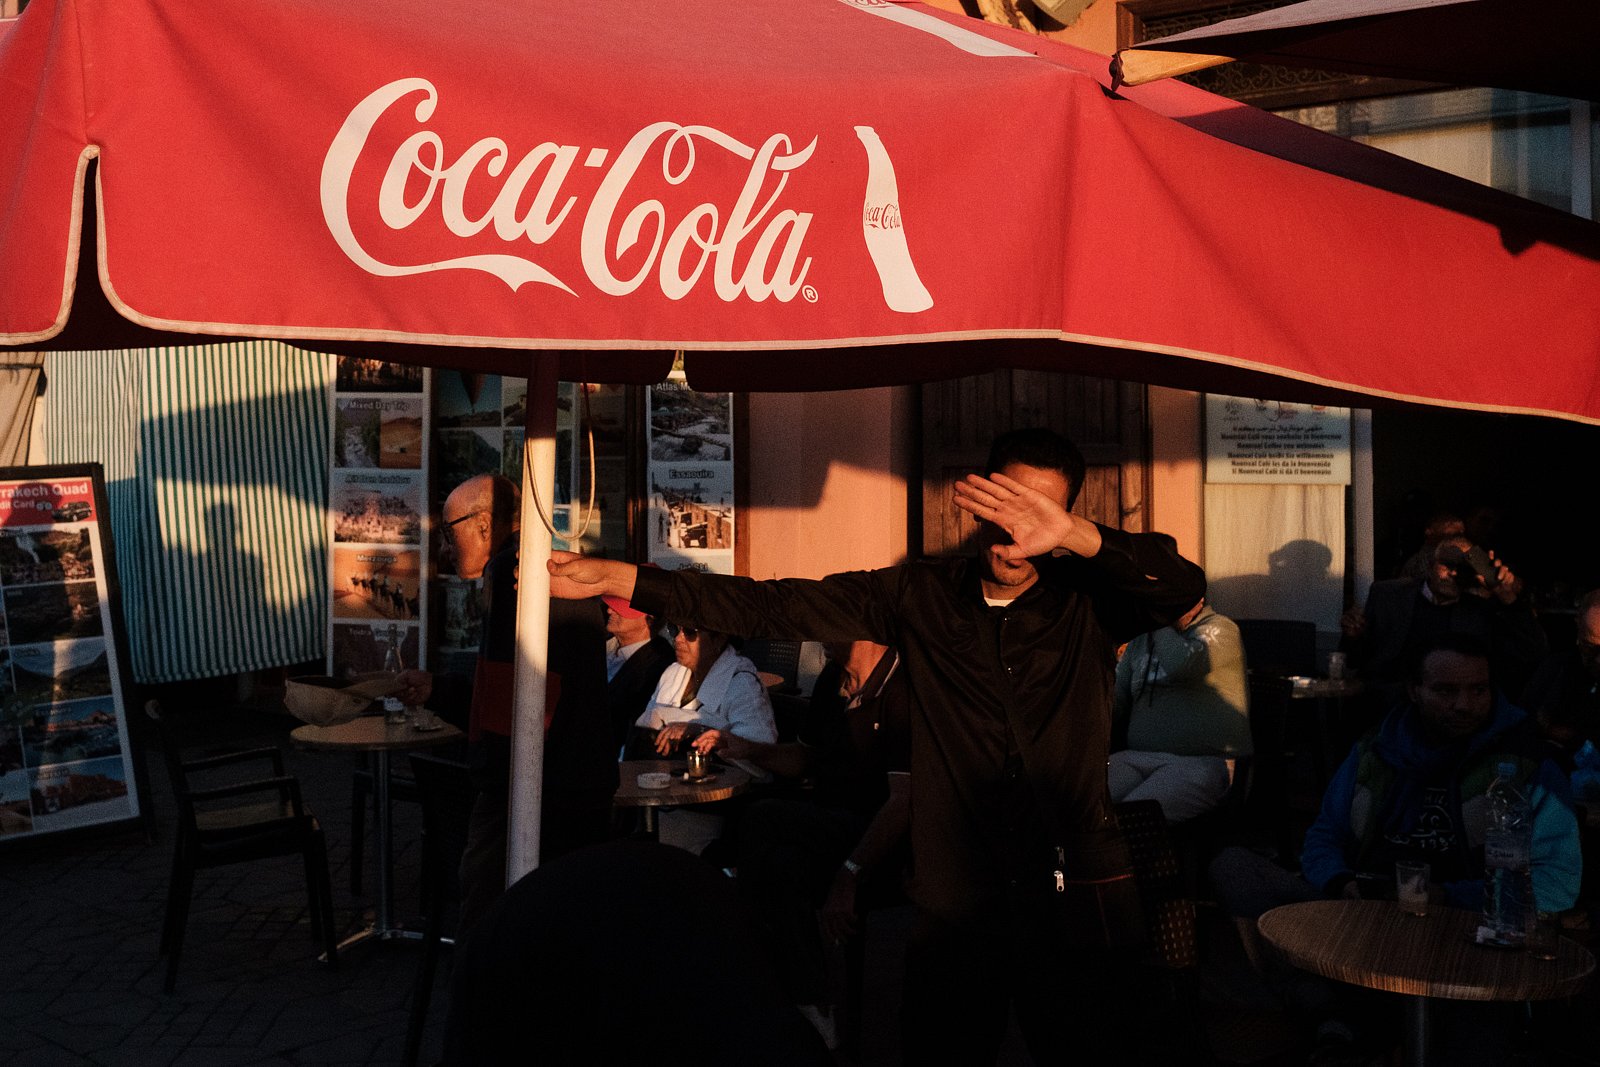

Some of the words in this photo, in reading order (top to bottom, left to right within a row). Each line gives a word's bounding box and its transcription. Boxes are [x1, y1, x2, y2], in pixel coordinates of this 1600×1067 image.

[320, 77, 818, 303] Coca-Cola
[656, 382, 678, 391] Atlas
[349, 401, 374, 409] Mixed
[669, 469, 714, 479] Essaouira
[52, 482, 88, 495] Quad
[13, 500, 35, 509] Card
[357, 554, 398, 565] Merzouga
